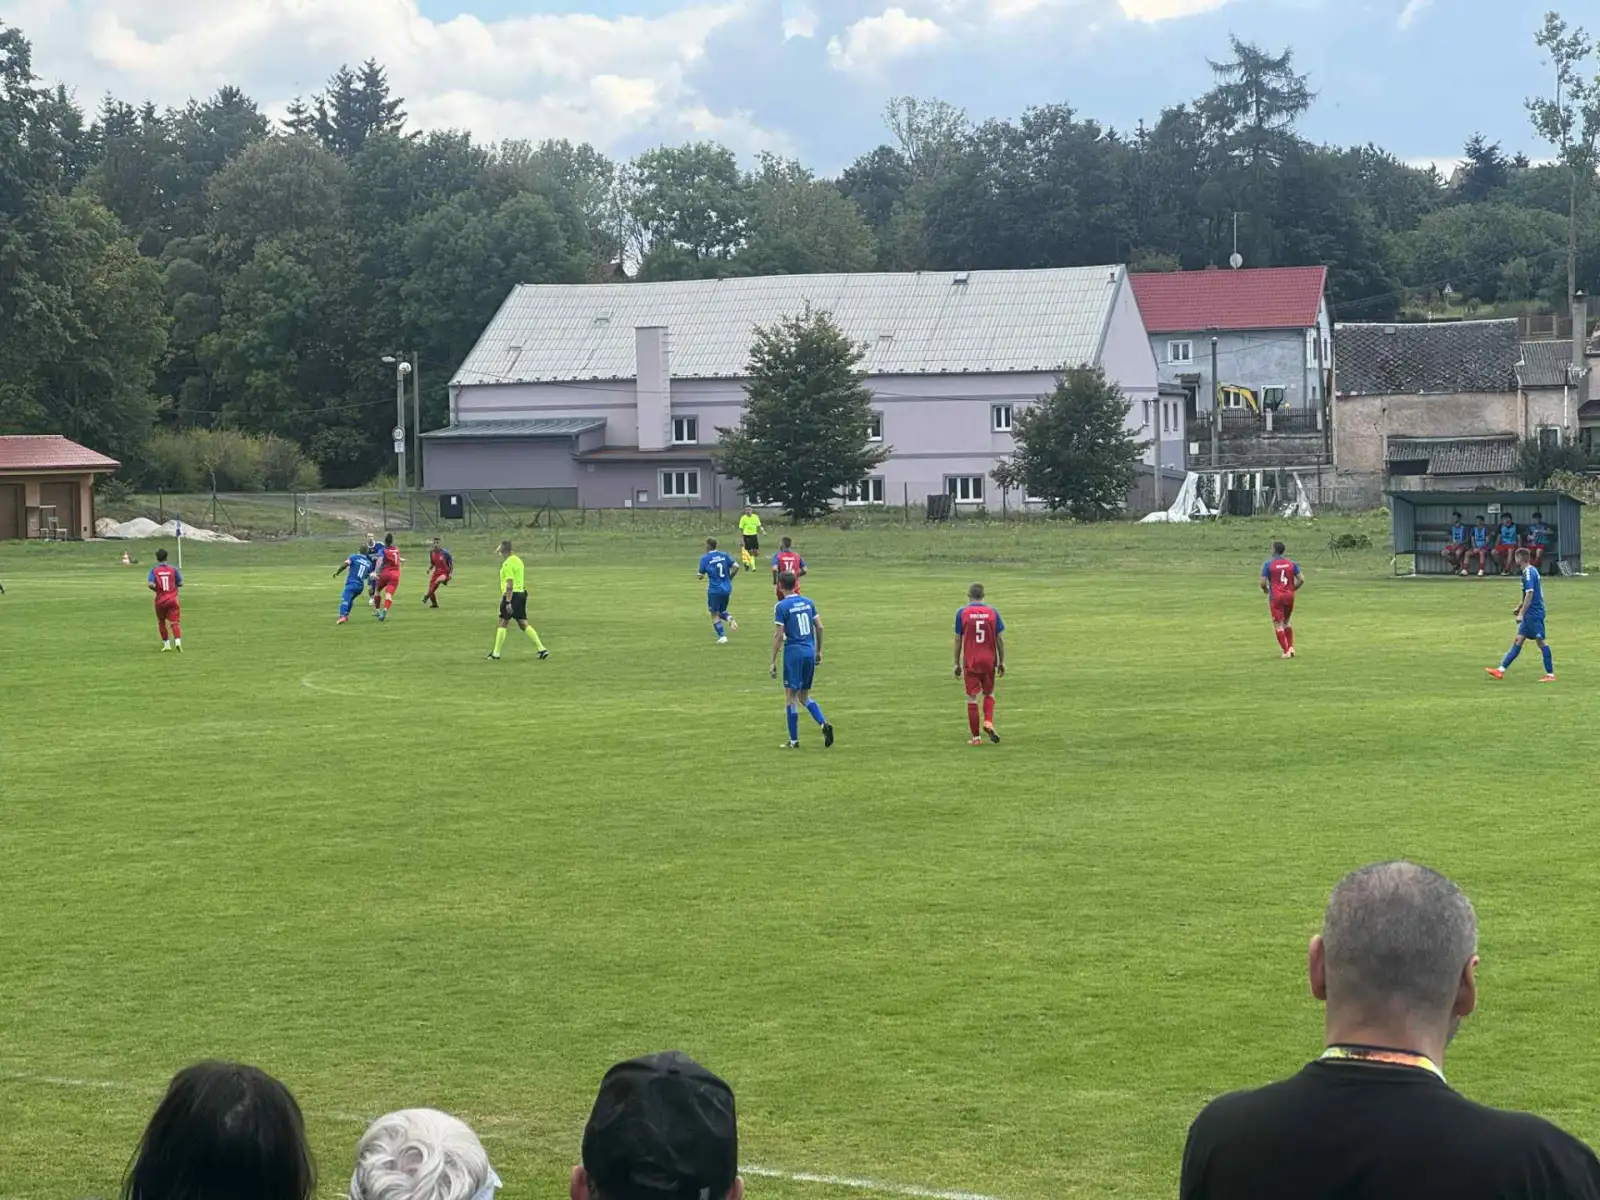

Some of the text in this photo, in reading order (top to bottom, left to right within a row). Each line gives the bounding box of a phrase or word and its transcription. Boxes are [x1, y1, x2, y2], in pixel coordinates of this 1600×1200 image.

[357, 564, 366, 579] 11
[716, 563, 725, 577] 2
[1280, 569, 1288, 585] 4
[160, 576, 169, 591] 11
[796, 612, 811, 636] 10
[975, 620, 985, 643] 5
